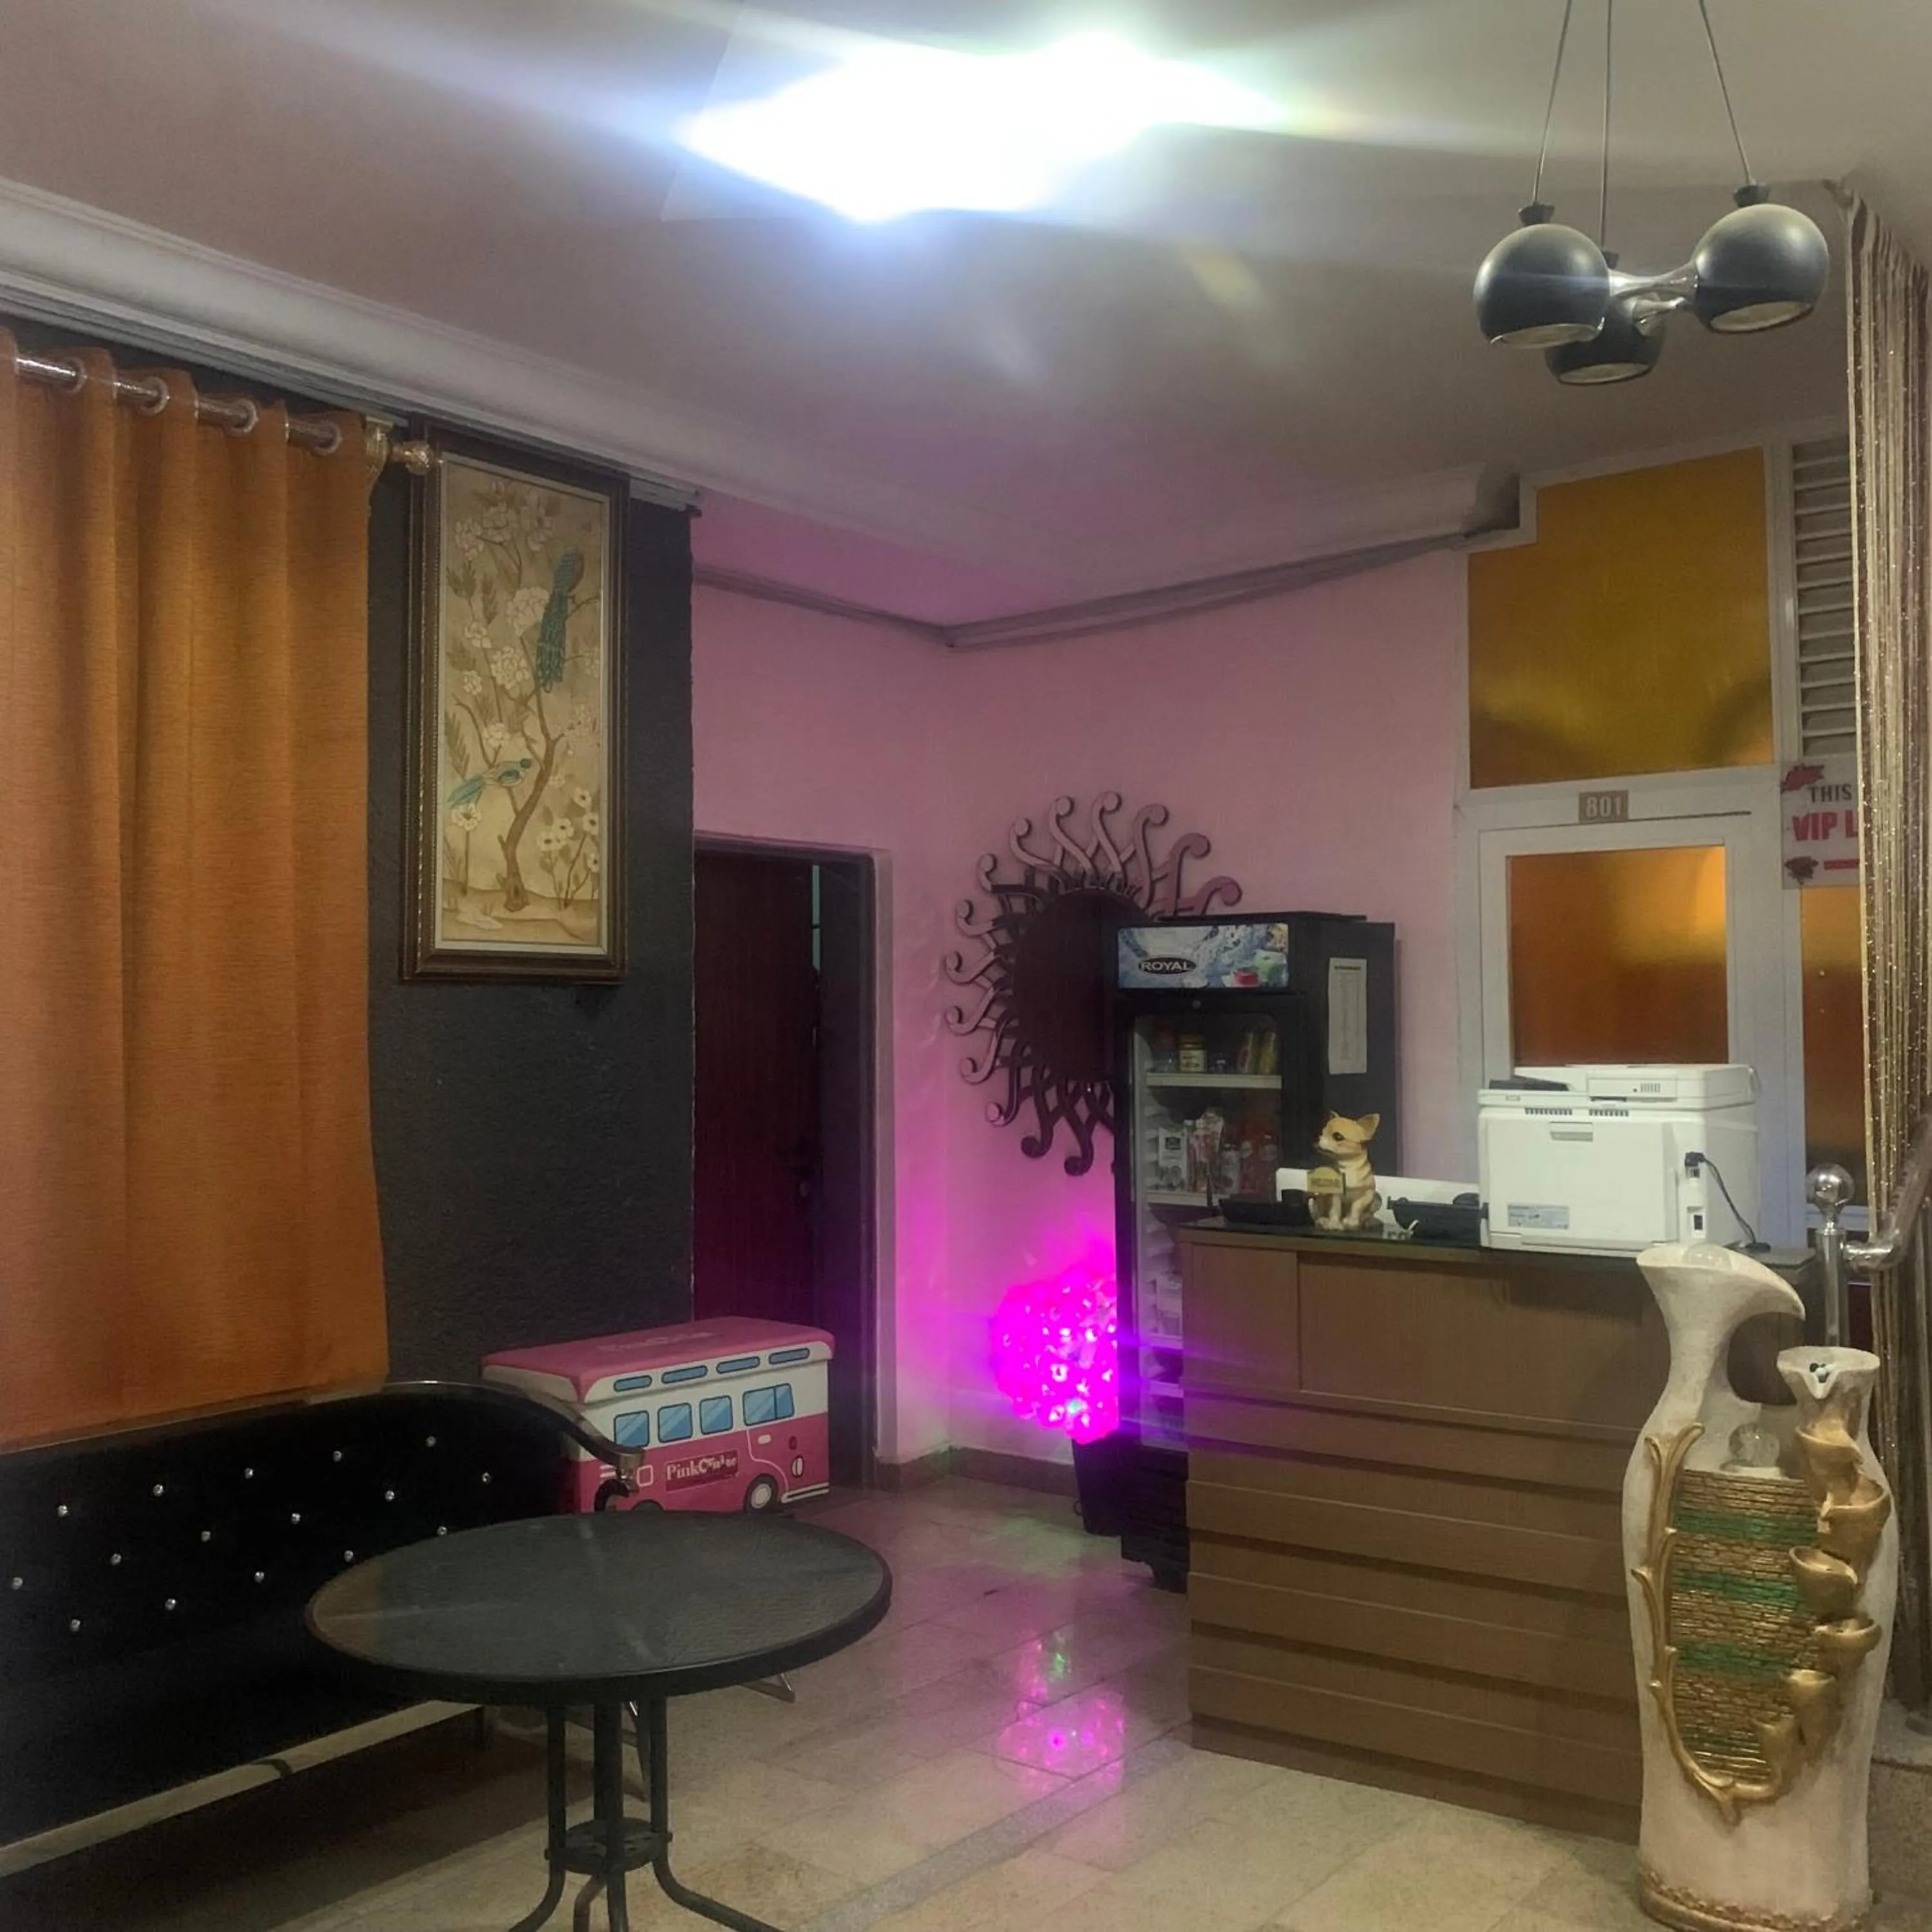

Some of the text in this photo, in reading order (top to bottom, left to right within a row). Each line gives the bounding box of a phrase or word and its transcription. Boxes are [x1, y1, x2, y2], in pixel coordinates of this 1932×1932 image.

[1808, 783, 1852, 803] THIS
[1586, 795, 1622, 818] 801
[1792, 810, 1859, 842] VIP L
[1141, 961, 1193, 971] ROYAL
